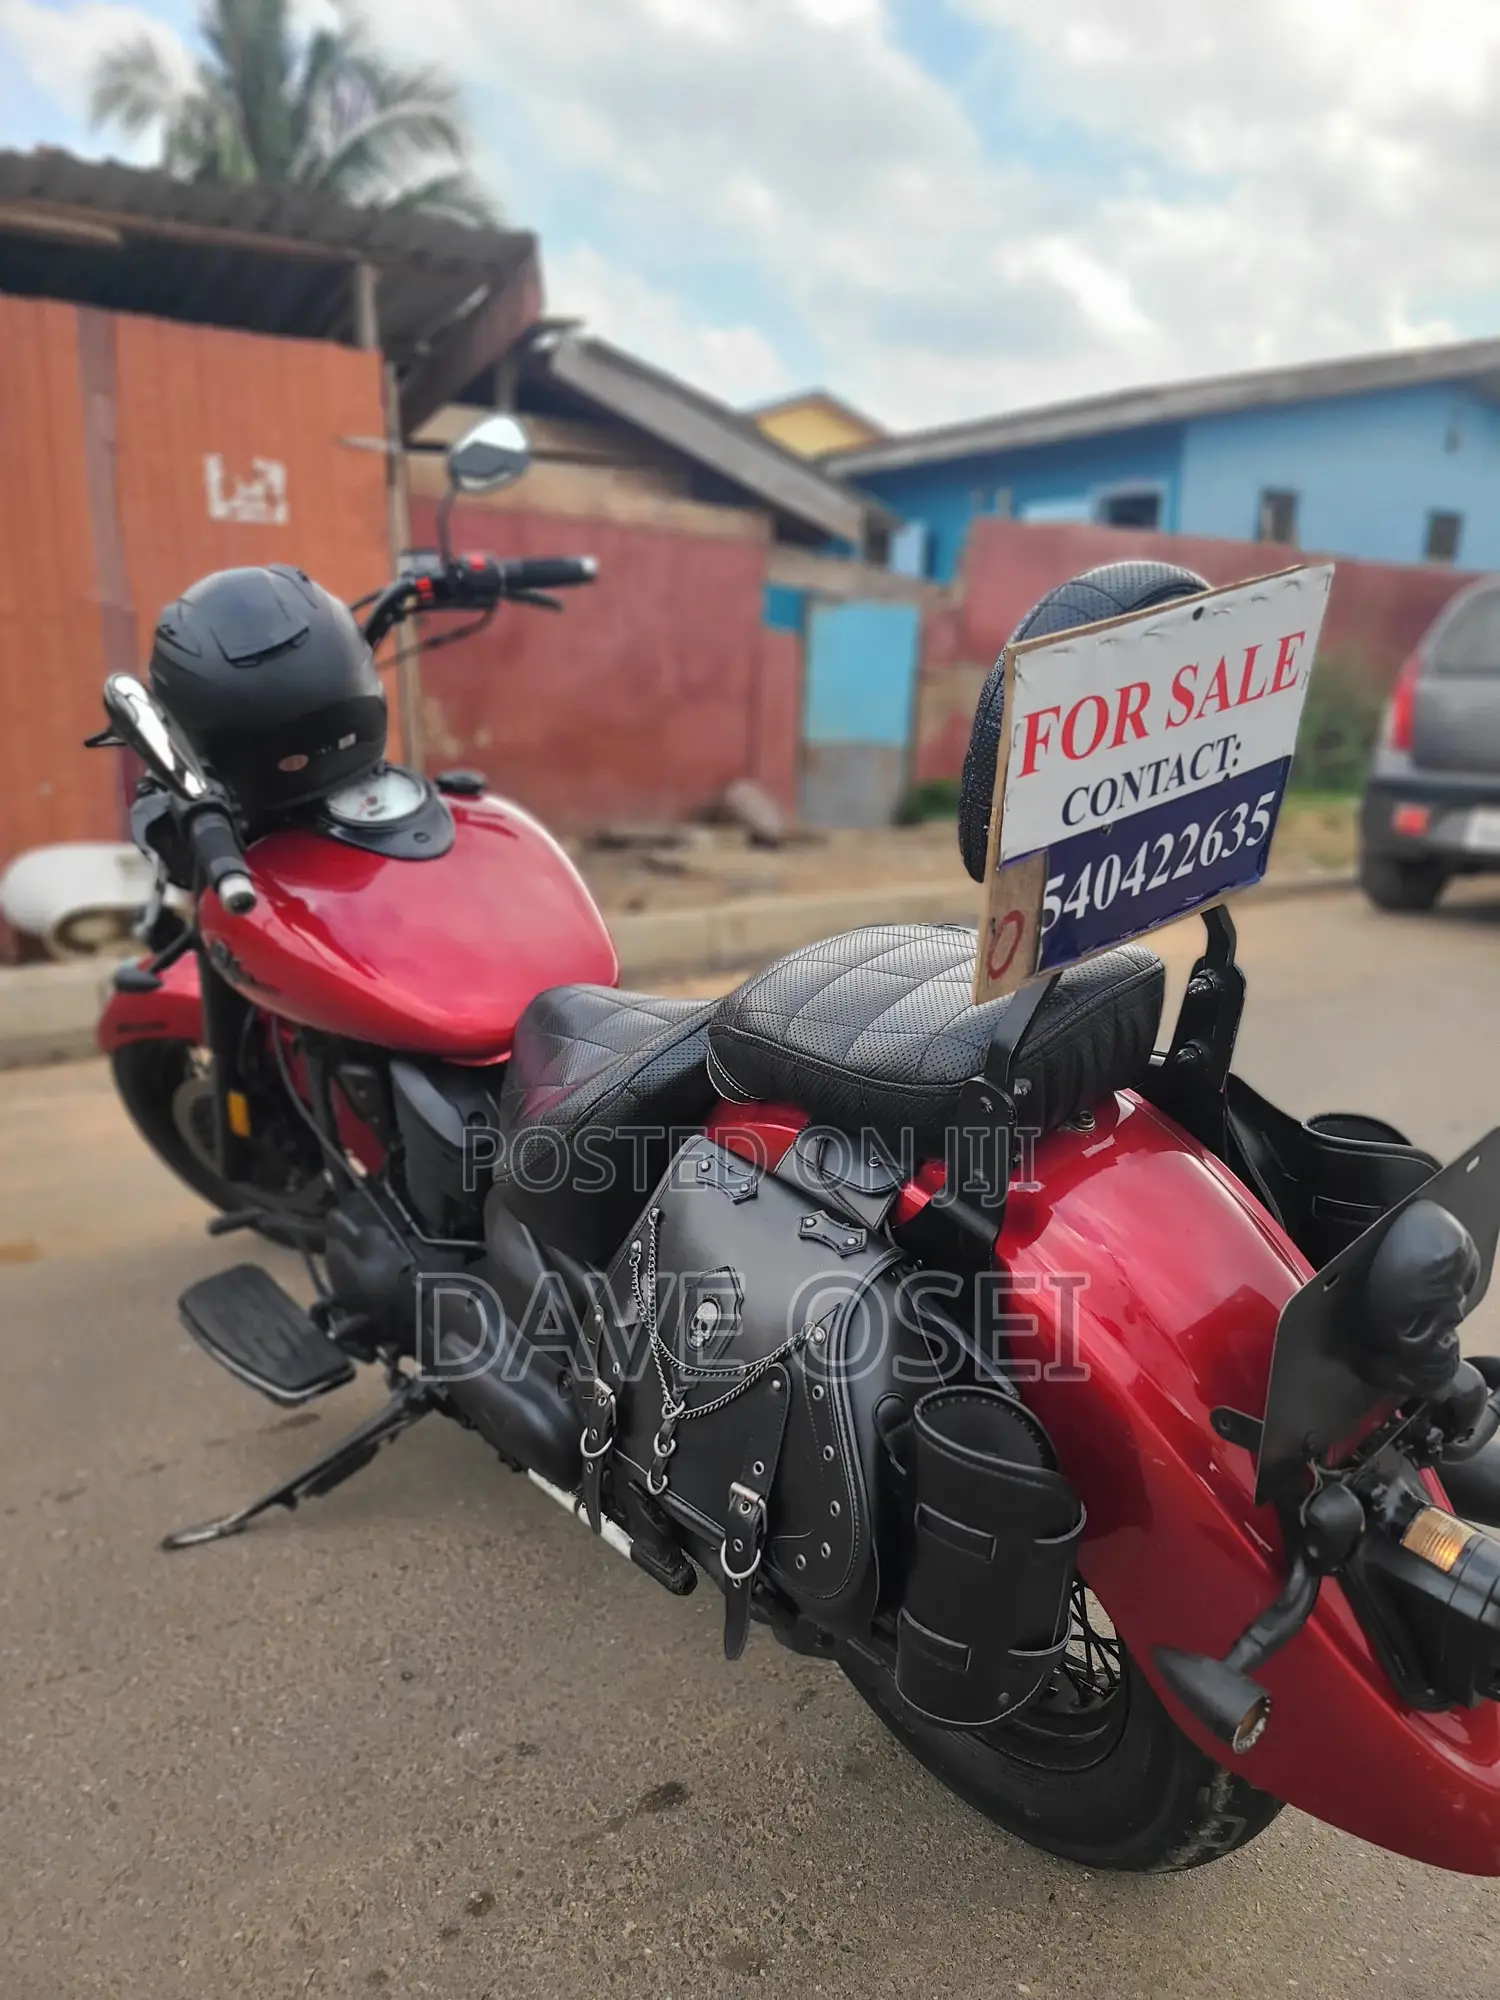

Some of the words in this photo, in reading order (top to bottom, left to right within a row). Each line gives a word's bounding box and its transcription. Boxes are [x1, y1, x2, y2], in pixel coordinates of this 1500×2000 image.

[1016, 682, 1151, 778] FOR
[1165, 631, 1305, 728] SALE
[1062, 733, 1241, 826] CONTACT:
